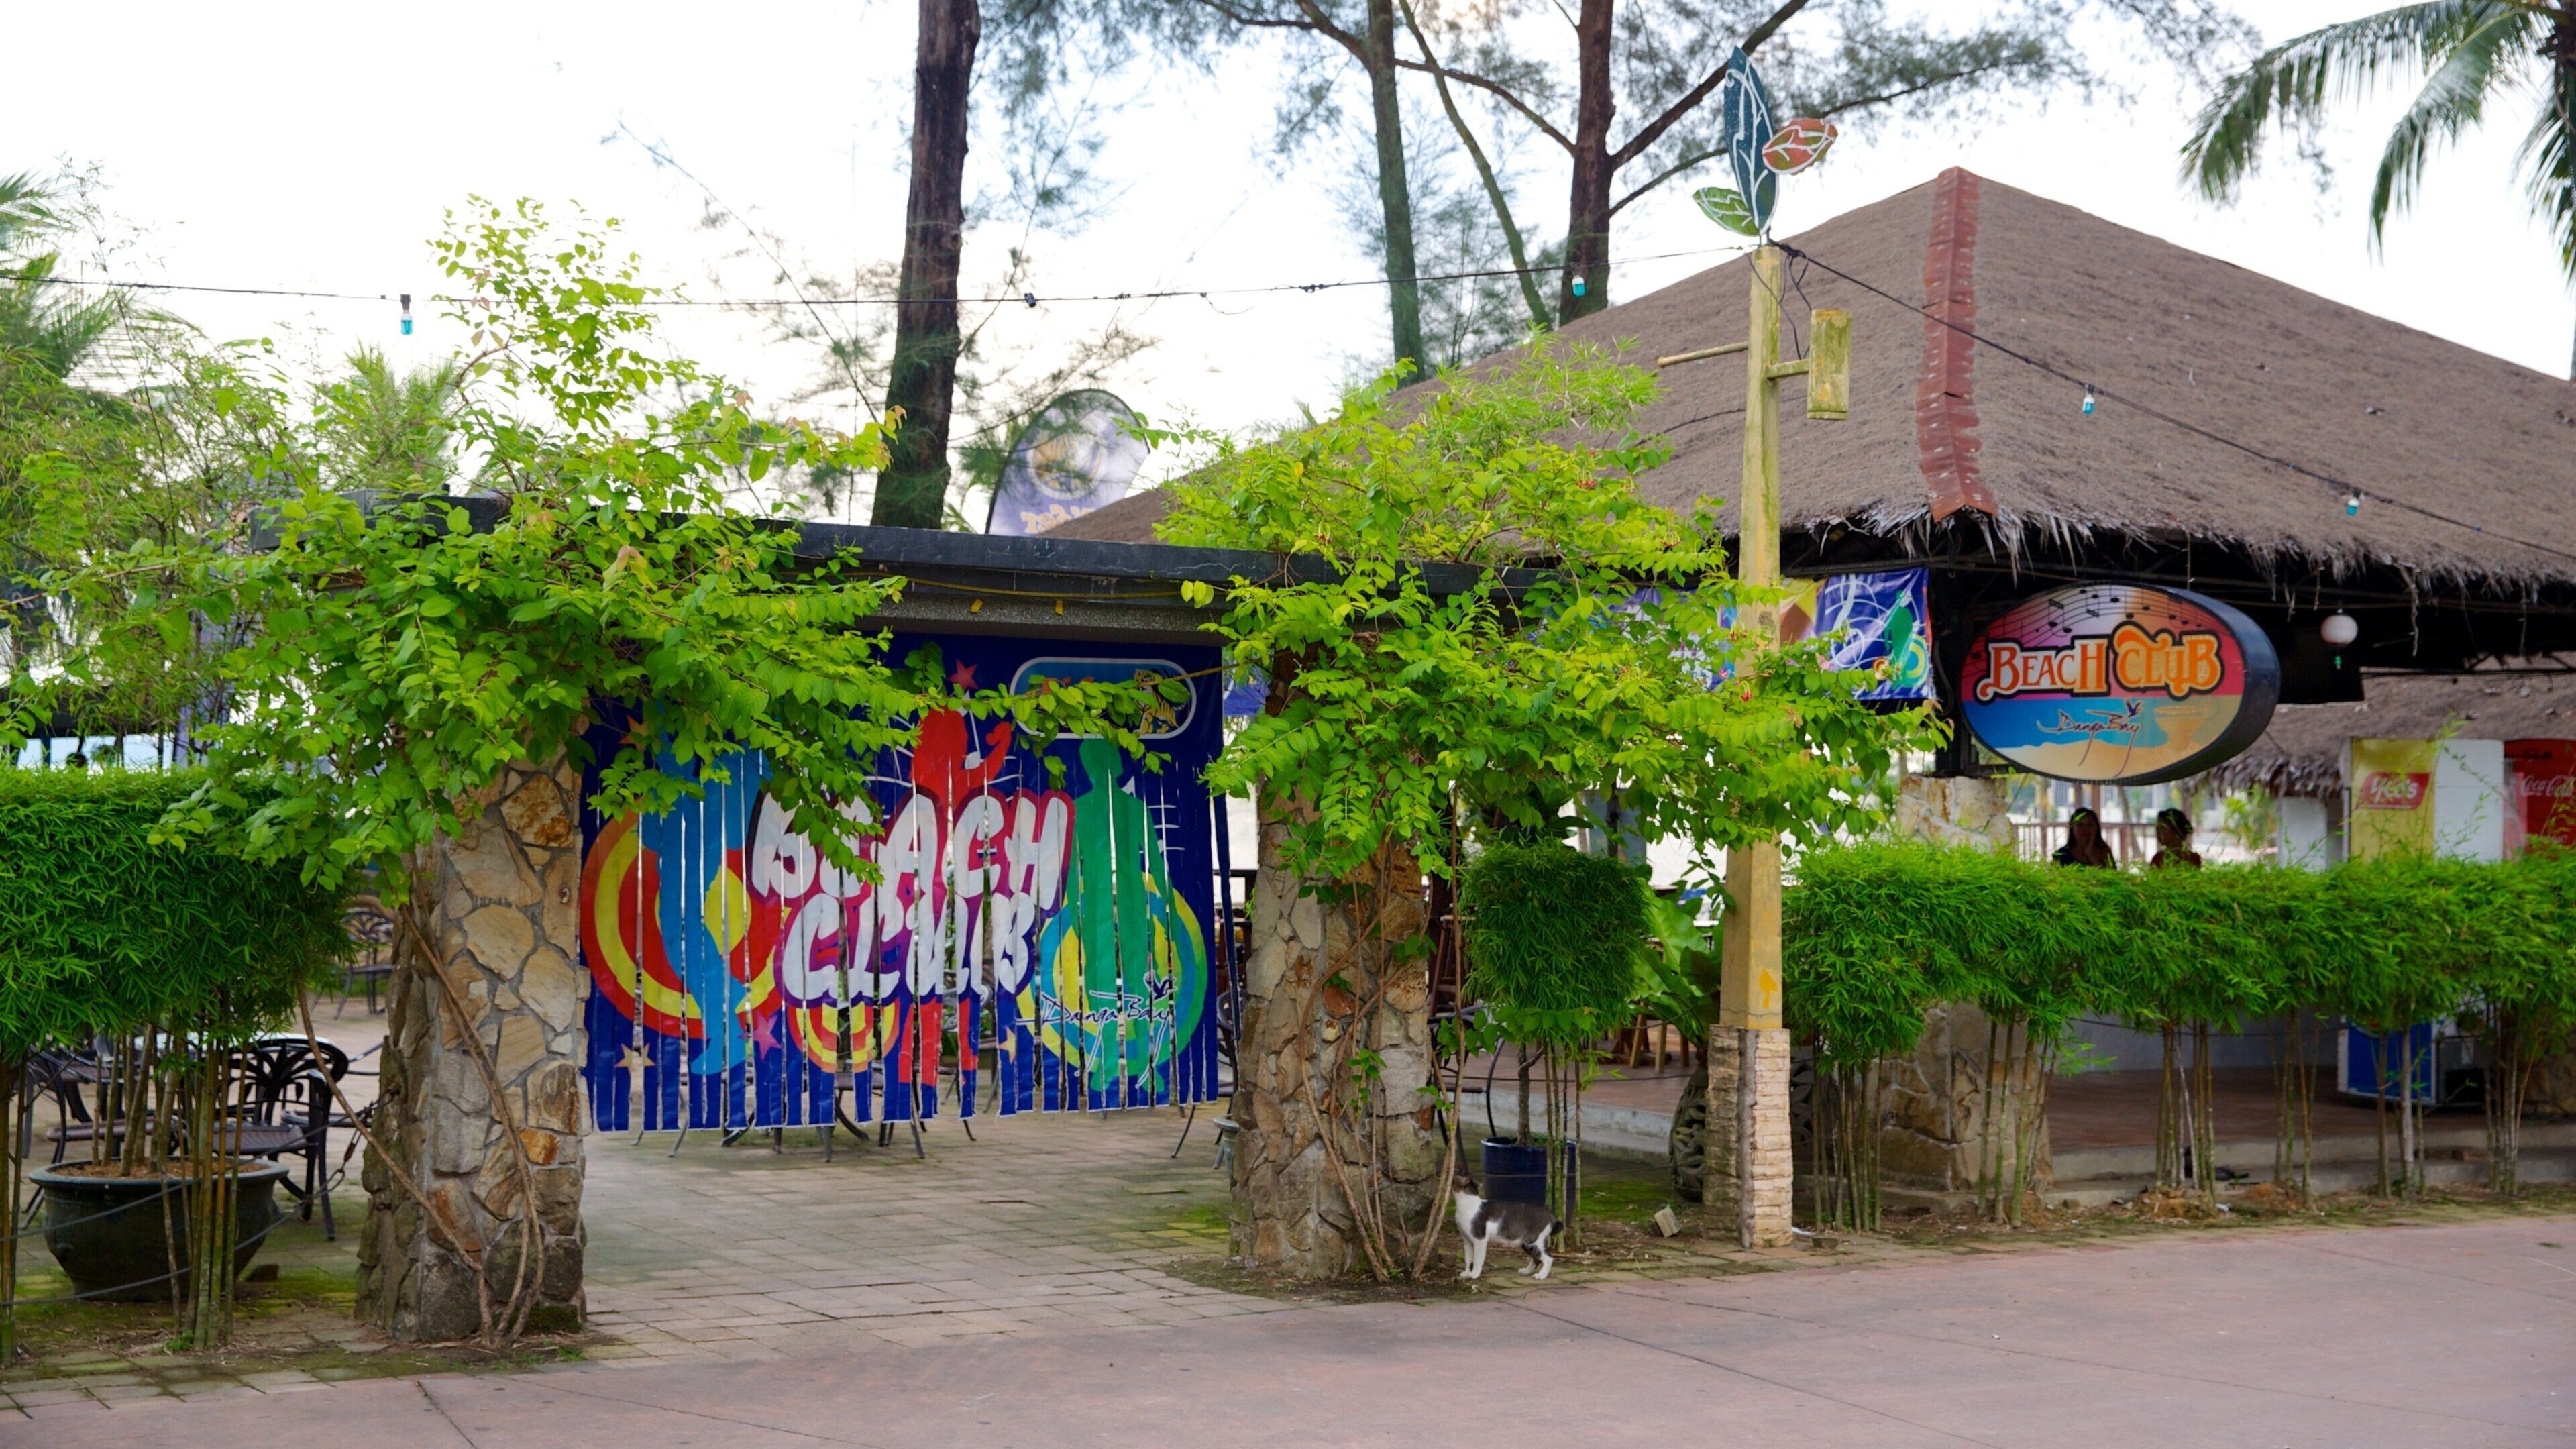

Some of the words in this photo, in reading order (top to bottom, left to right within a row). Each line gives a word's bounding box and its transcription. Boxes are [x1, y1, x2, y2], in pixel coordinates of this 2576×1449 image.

[1977, 638, 2109, 701] BEACH
[2112, 623, 2222, 698] CLUB
[2037, 709, 2105, 766] Danga
[2086, 709, 2141, 778] Bay
[783, 893, 1036, 1000] CLUB
[1016, 991, 1119, 1077] Danga
[1089, 989, 1170, 1089] Bay
